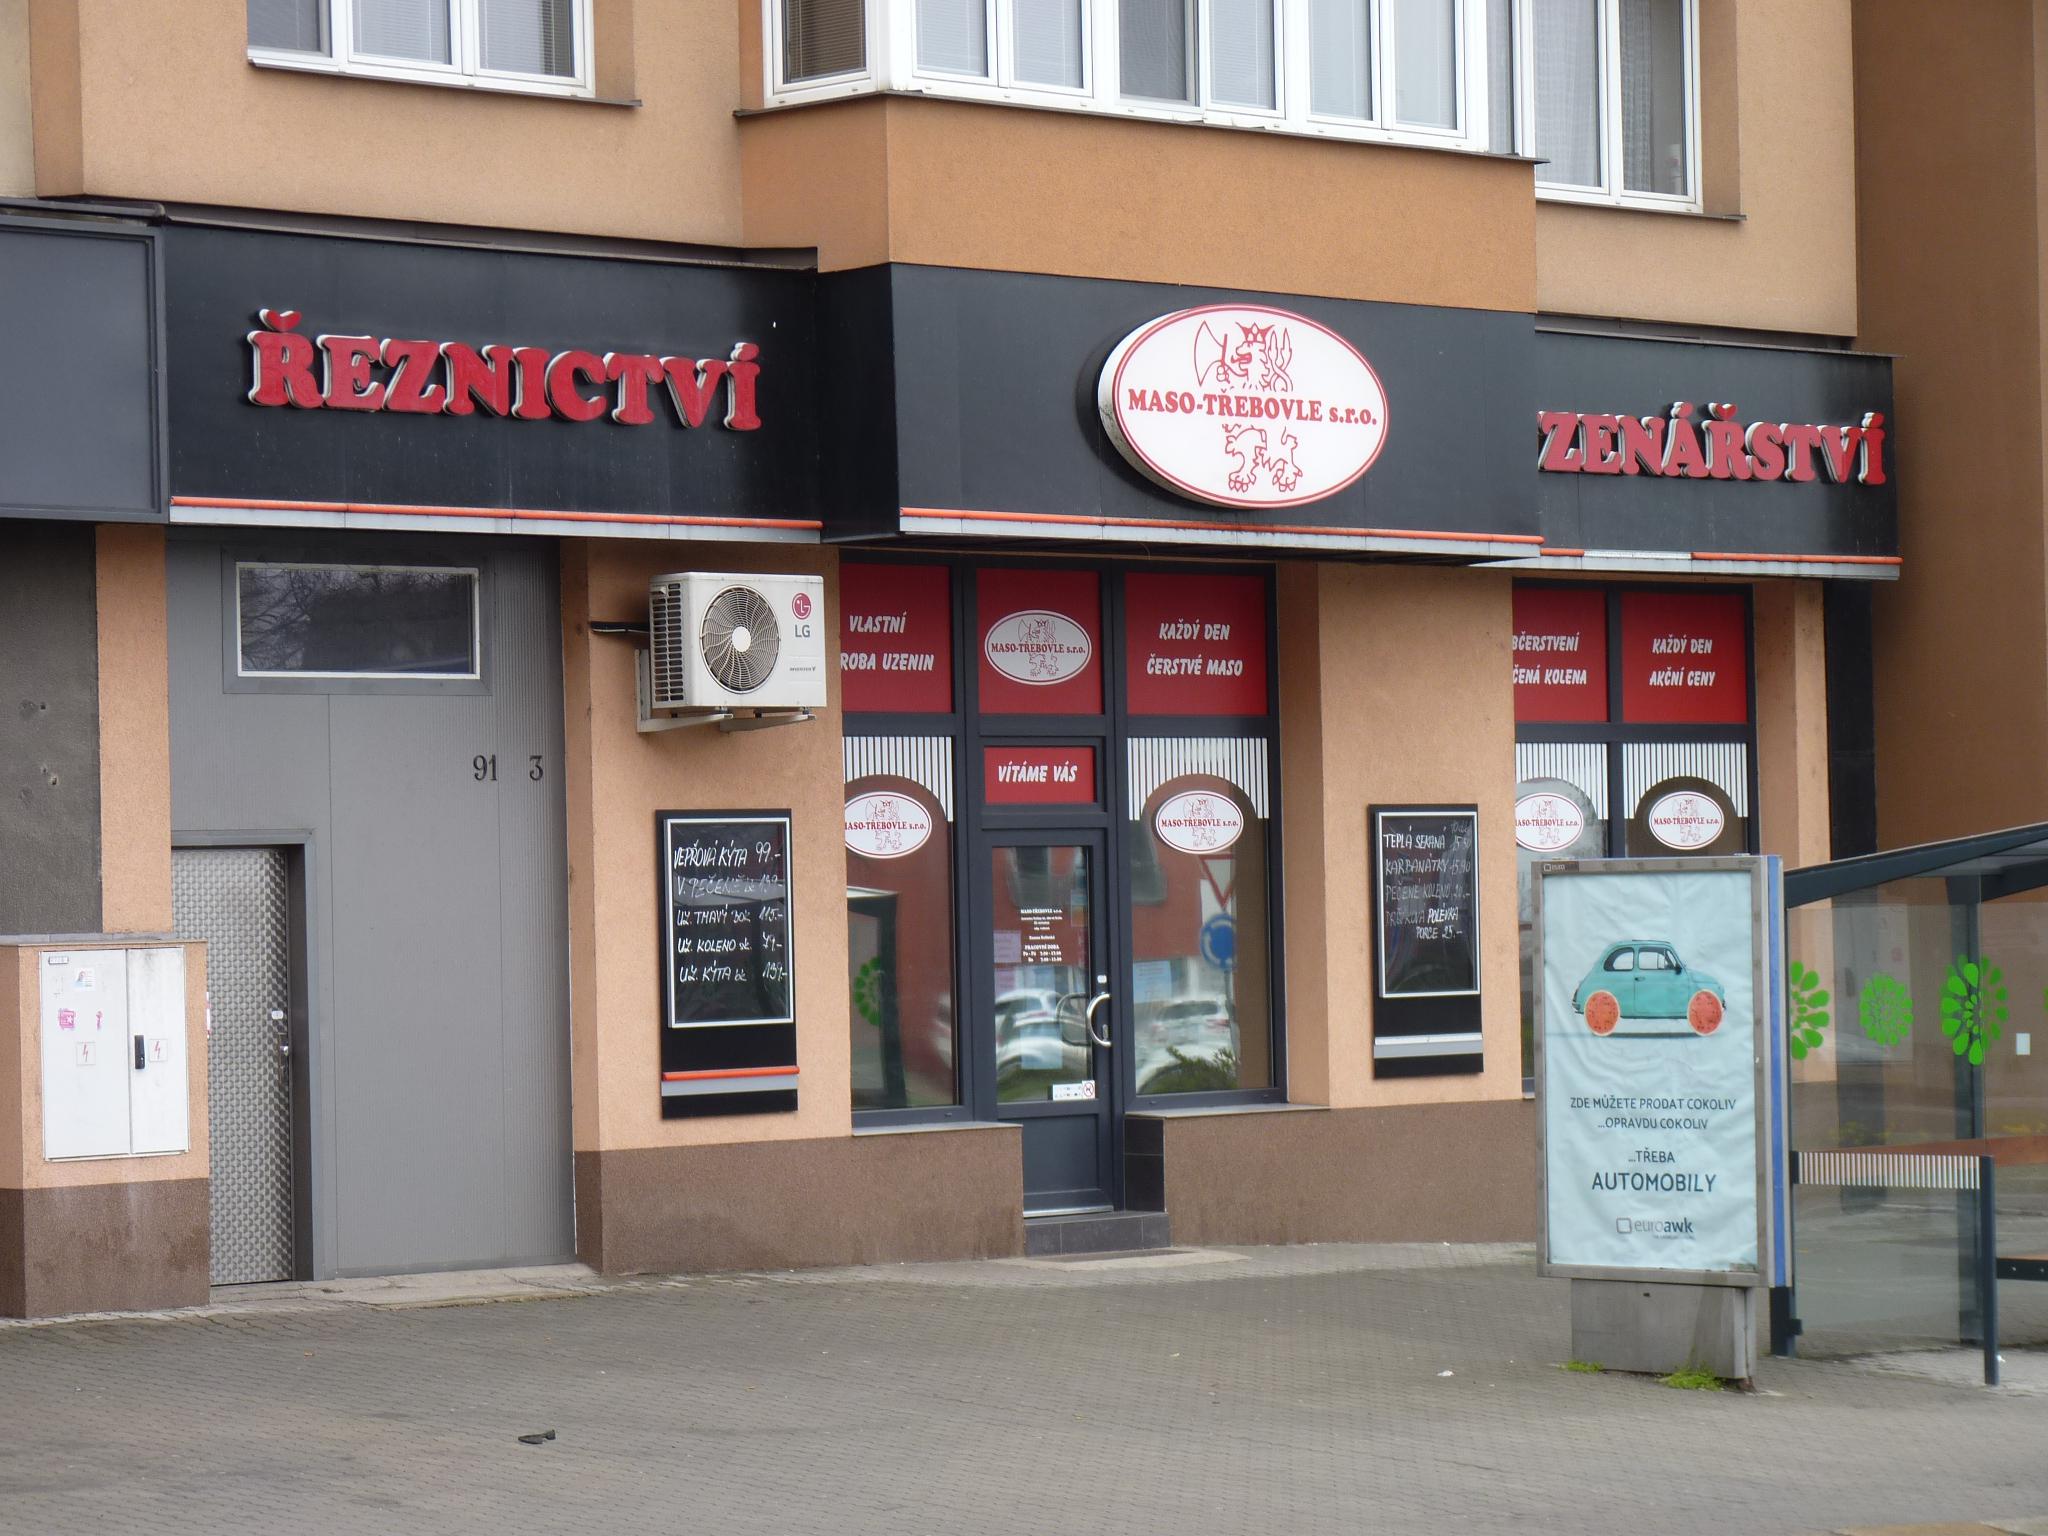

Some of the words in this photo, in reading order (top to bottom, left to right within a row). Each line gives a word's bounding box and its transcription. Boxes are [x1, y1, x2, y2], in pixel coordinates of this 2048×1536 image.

[248, 308, 761, 431] ŘEZNICTVÍ
[1128, 388, 1322, 421] MASO-TŘEBOVLE
[1329, 409, 1378, 425] s.r.o.
[1537, 402, 1886, 485] ZENÁŘSTVÍ
[794, 624, 811, 639] LG
[849, 610, 907, 633] VLASTNÍ
[1159, 618, 1200, 640] KAŽDÝ
[1204, 624, 1230, 640] DEN
[991, 641, 1064, 654] MASO-TŘEBOVLE
[1066, 646, 1086, 654] s.r.o.
[1652, 634, 1687, 654] KAŽDÝ
[1690, 639, 1713, 654] DEN
[882, 652, 935, 671] UZENIN
[1146, 653, 1203, 676] ČERSTVÉ
[1206, 659, 1243, 676] MASO
[1544, 668, 1587, 685] KOLENA
[1649, 666, 1685, 687] AKČNÍ
[1687, 671, 1716, 687] CENY
[998, 760, 1049, 782] VÍTÁME
[1053, 760, 1078, 782] VÁS
[1161, 817, 1221, 828] MASO-TŘEBOVLE
[1516, 817, 1564, 827] ASO-TŘEBOVLE
[1383, 825, 1413, 849] TEPLÁ
[1415, 826, 1446, 849] SEKANÁ
[674, 839, 718, 869] VEPŘOVÁ
[718, 839, 748, 867] KÝTA
[1385, 853, 1449, 876] KARBANÁTKY
[694, 904, 728, 924] TMAVÝ
[1427, 902, 1459, 924] POLÉVKA
[1416, 926, 1438, 939] PORCE
[697, 938, 736, 953] KOLENO
[701, 960, 732, 982] KÝTA
[1570, 1097, 1590, 1109] ZDE
[1593, 1094, 1637, 1109] MŮŽETE
[1640, 1098, 1684, 1110] PRODAT
[1687, 1098, 1737, 1110] COKOLIV
[1598, 1117, 1658, 1129] ...OPRAVDU
[1660, 1118, 1709, 1130] COKOLIV
[1628, 1147, 1676, 1163] ...TŘEBA
[1592, 1172, 1717, 1193] AUTOMOBILY
[1634, 1217, 1694, 1233] euroawk
